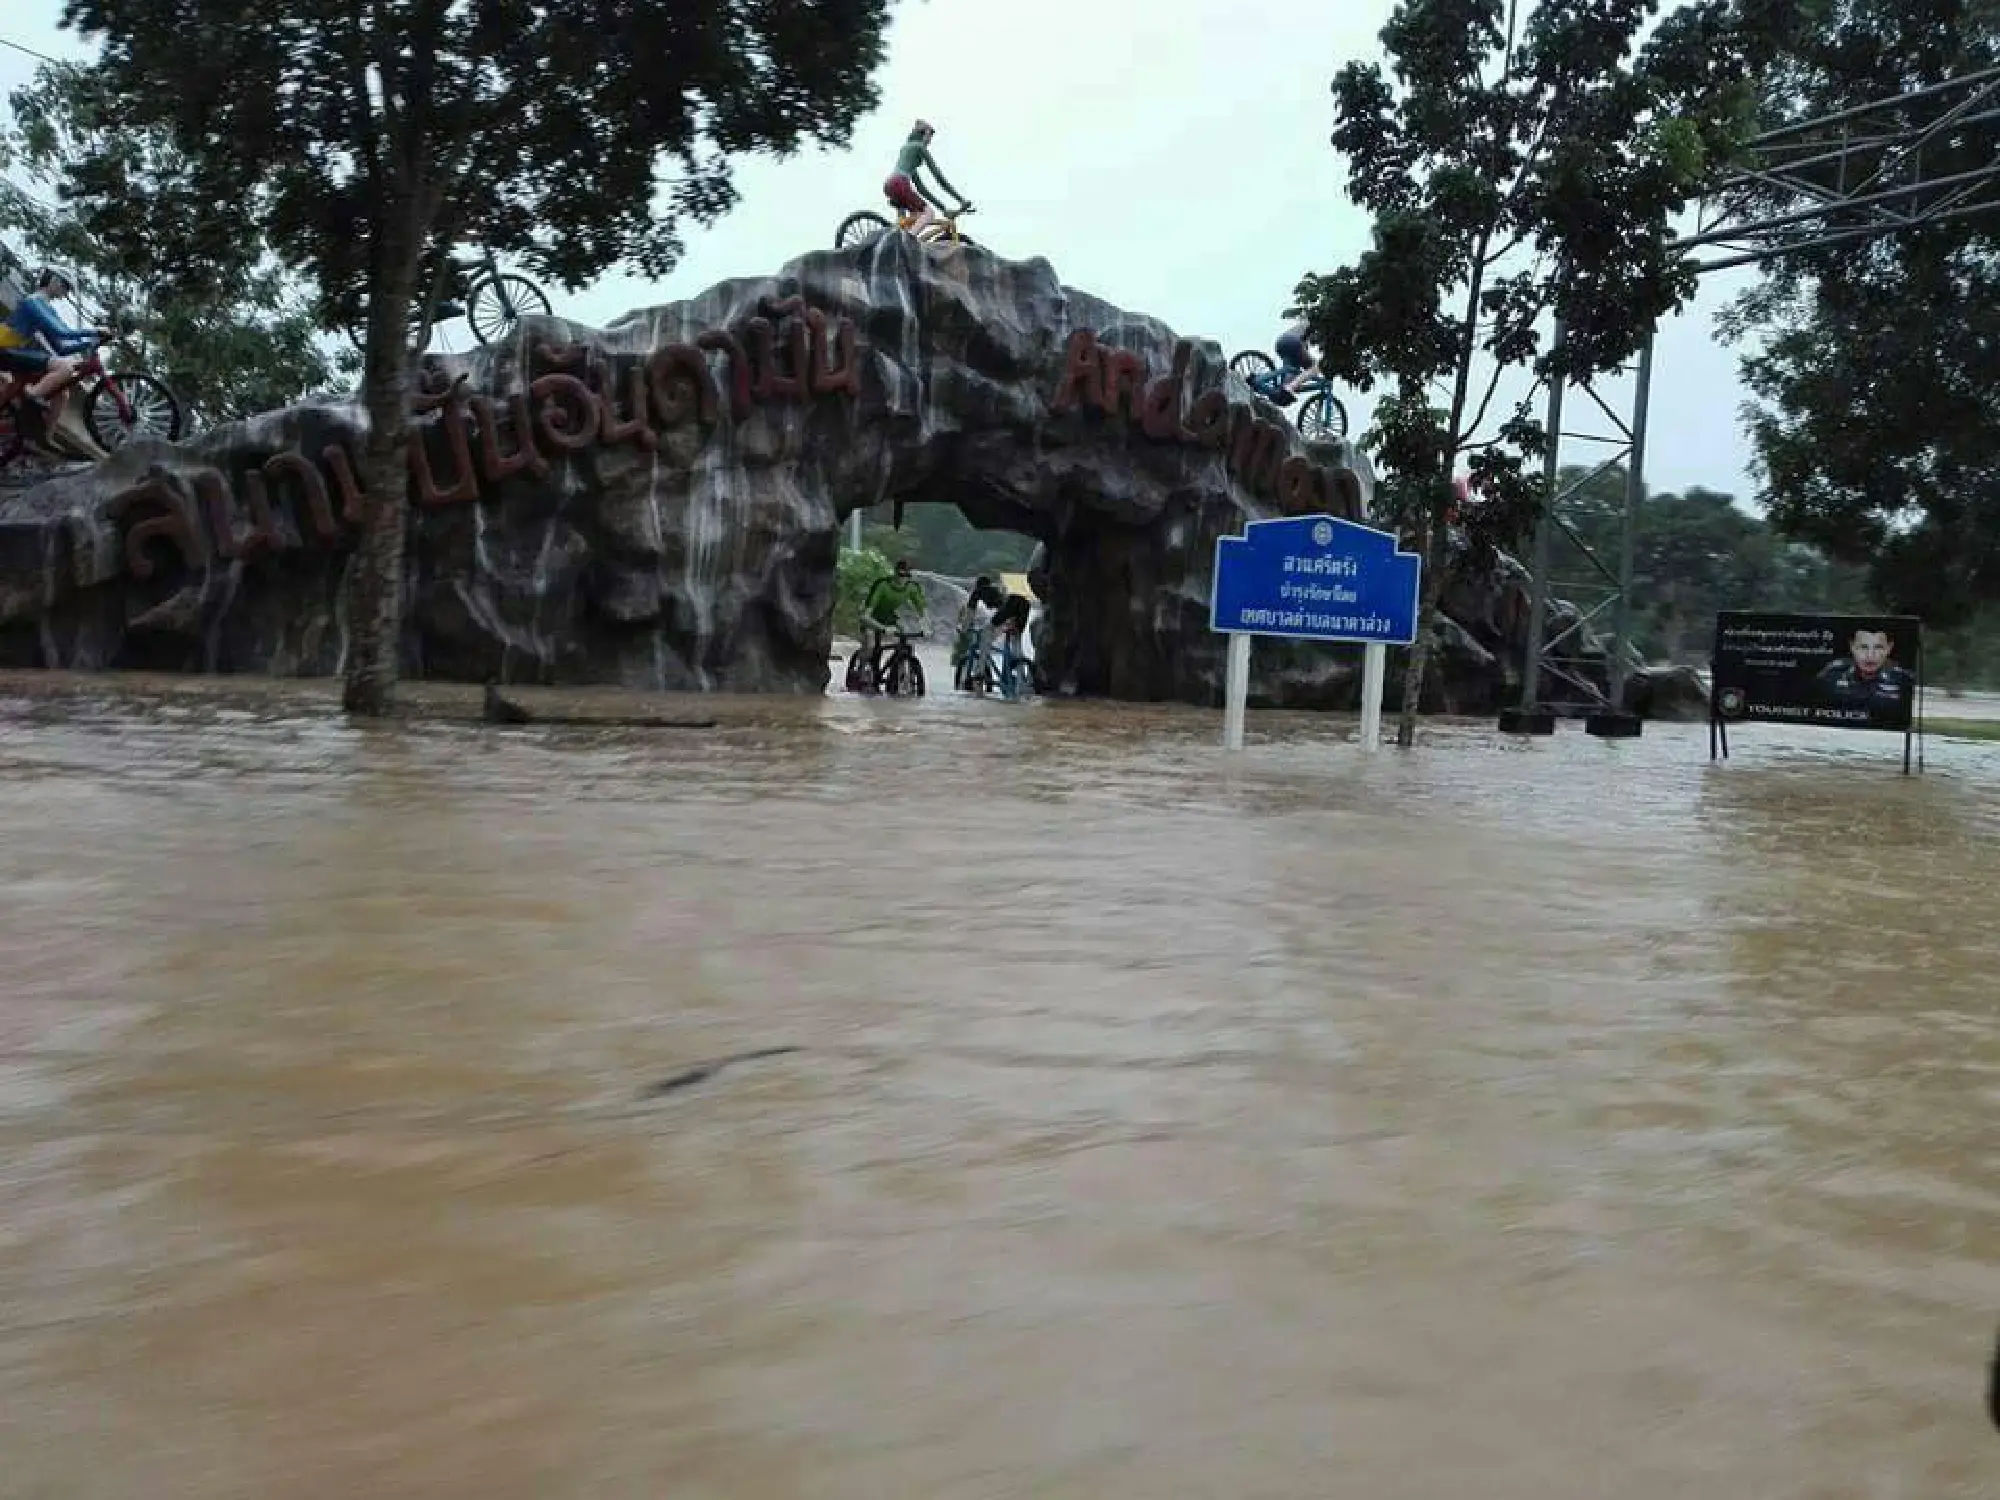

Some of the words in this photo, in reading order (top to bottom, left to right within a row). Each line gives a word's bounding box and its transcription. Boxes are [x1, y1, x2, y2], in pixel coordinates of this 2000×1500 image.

[1046, 328, 1362, 513] Andaman
[1750, 704, 1809, 716] TOURIST
[1815, 708, 1868, 719] POLICE
